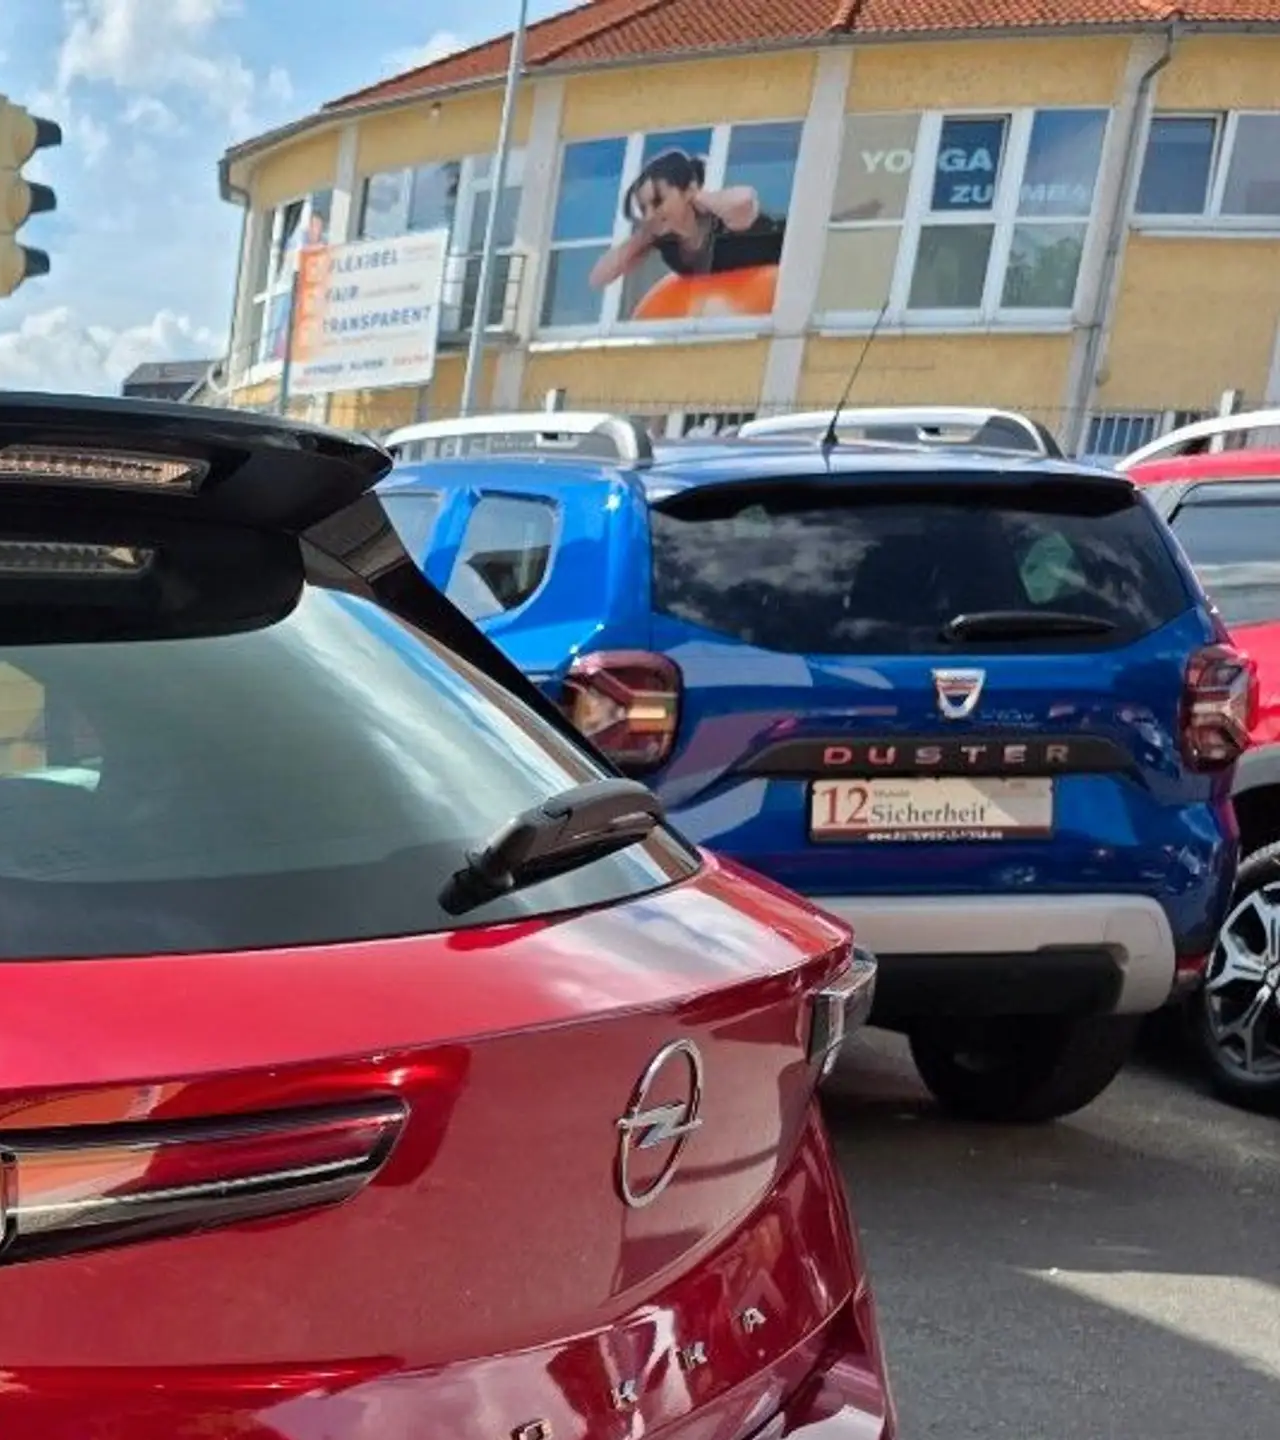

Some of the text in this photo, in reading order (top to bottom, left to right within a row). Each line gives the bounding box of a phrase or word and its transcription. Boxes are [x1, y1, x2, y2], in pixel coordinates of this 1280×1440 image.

[322, 306, 432, 333] TRANSPARENT
[823, 745, 1069, 764] DUSTER
[821, 786, 869, 824] 12
[871, 803, 987, 824] Sicherheit
